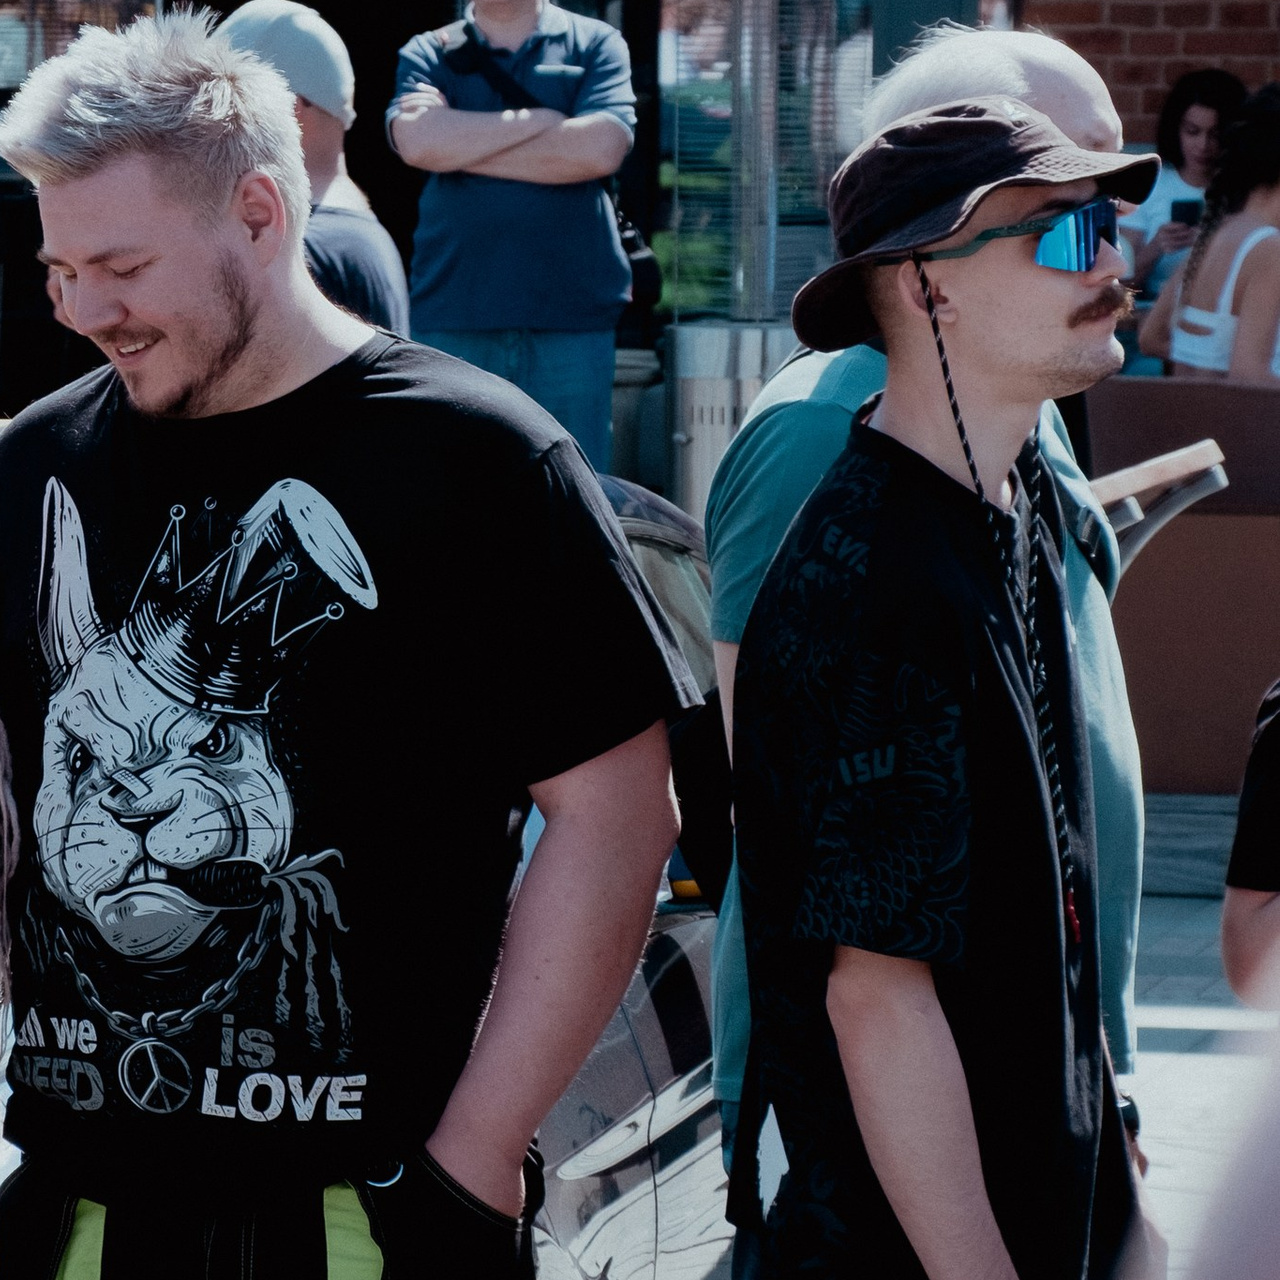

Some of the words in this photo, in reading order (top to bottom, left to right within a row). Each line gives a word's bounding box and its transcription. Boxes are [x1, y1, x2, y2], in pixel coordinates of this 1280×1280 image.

[50, 1017, 98, 1054] we
[220, 1015, 276, 1069] is
[201, 1067, 367, 1122] LOVE
